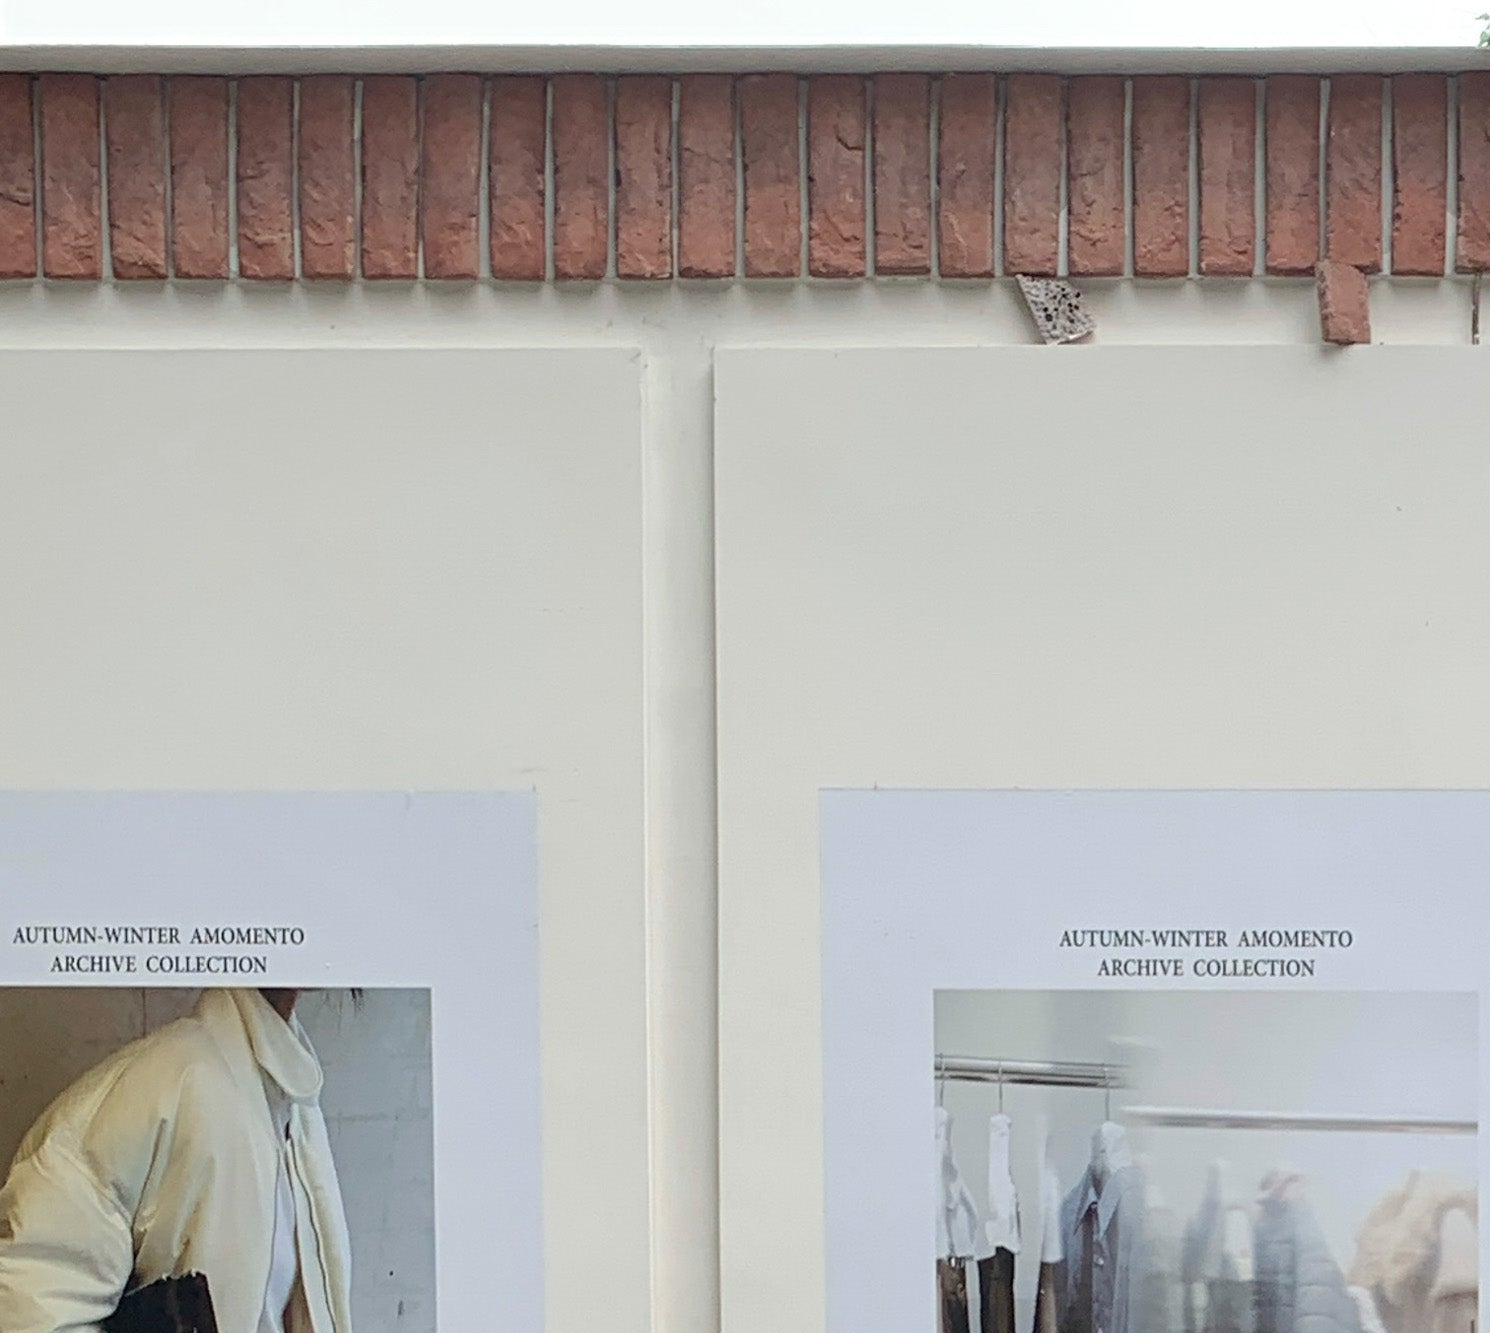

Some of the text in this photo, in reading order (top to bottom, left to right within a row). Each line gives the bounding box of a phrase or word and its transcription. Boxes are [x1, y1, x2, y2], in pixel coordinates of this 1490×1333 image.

[13, 926, 305, 946] AUTUMN-WINTER AMOMENTO
[1059, 929, 1354, 949] AUTUMN-WINTER AMOMENTO
[50, 955, 268, 974] ARCHIVE COLLECTION
[1097, 958, 1316, 978] ARCHIVE COLLECTION
